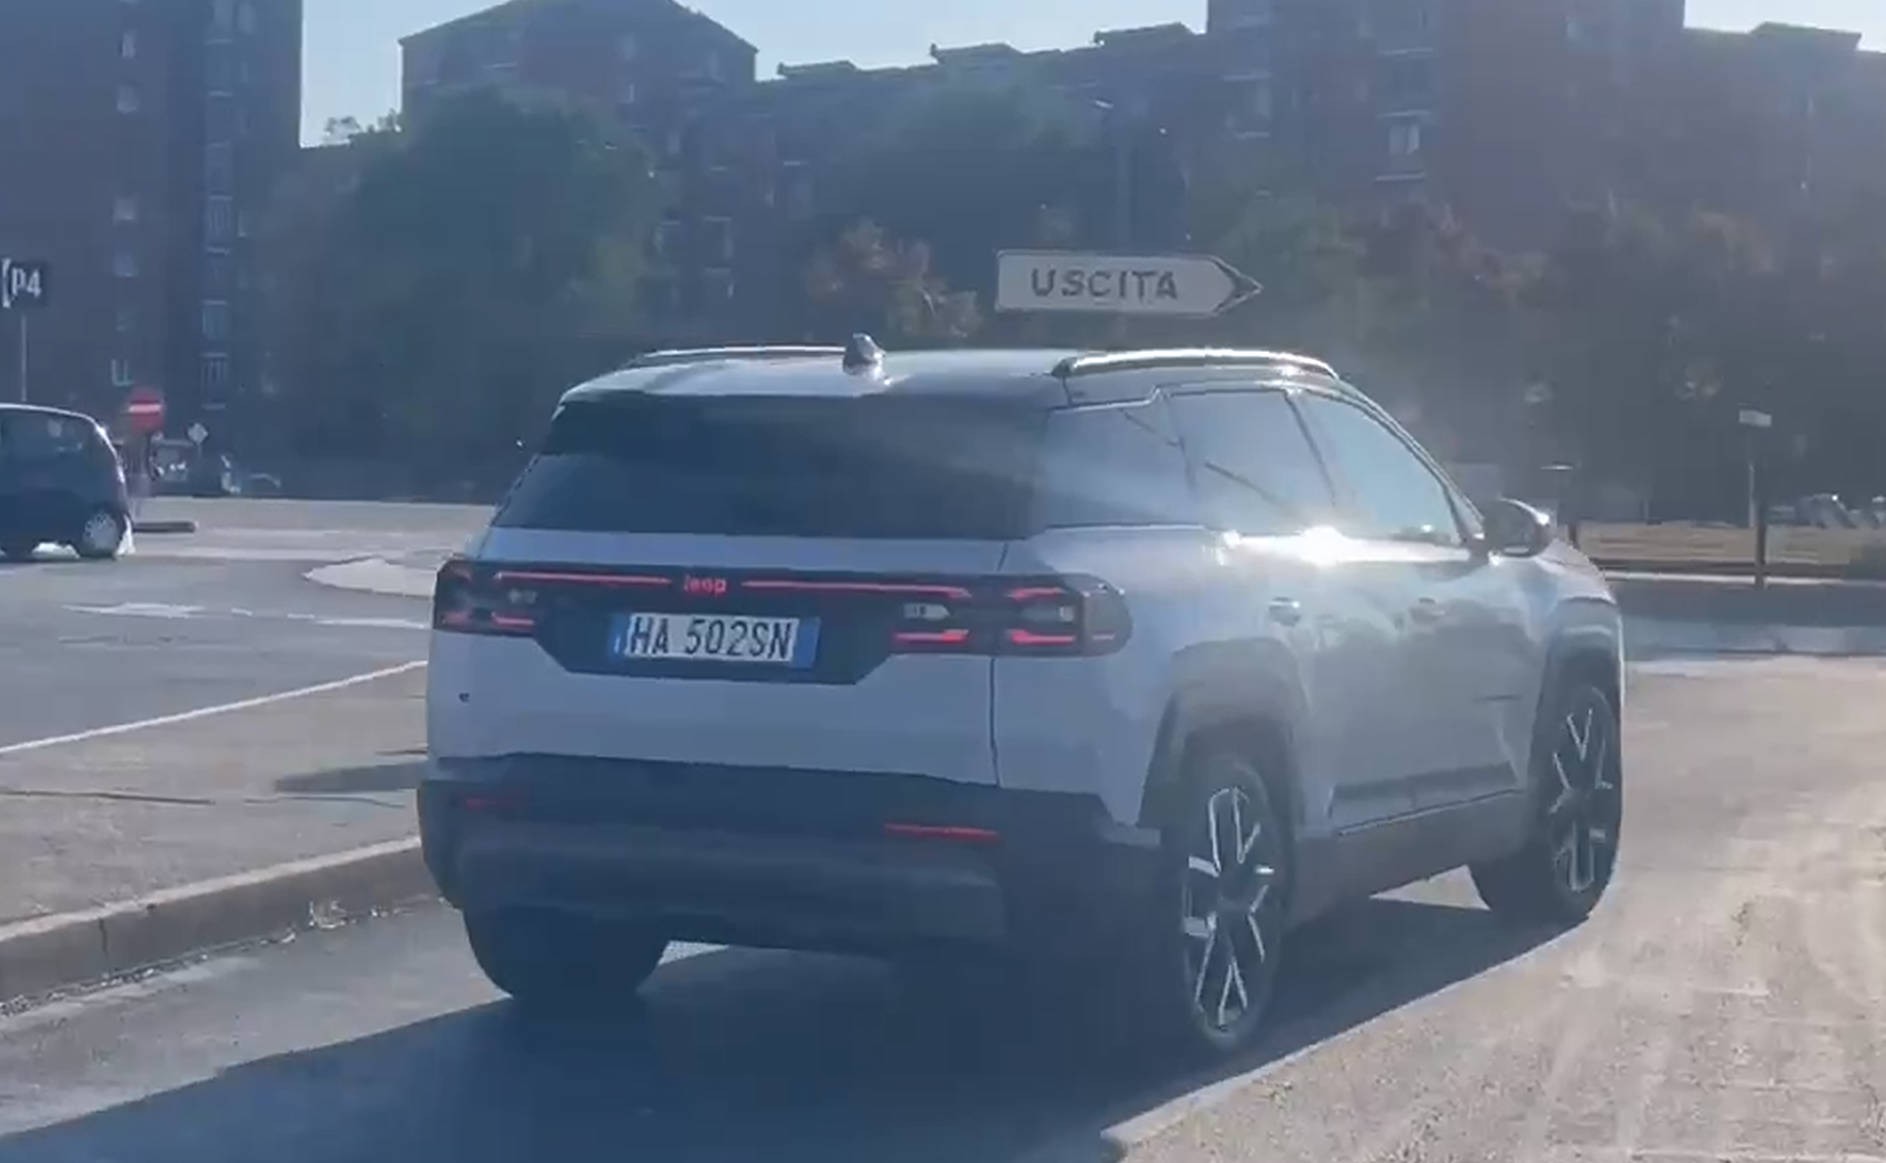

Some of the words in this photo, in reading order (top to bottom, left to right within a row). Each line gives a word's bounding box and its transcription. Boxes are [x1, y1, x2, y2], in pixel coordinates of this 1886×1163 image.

[1031, 268, 1178, 300] USCITA
[630, 616, 669, 654] HA
[684, 617, 792, 659] 502SN
